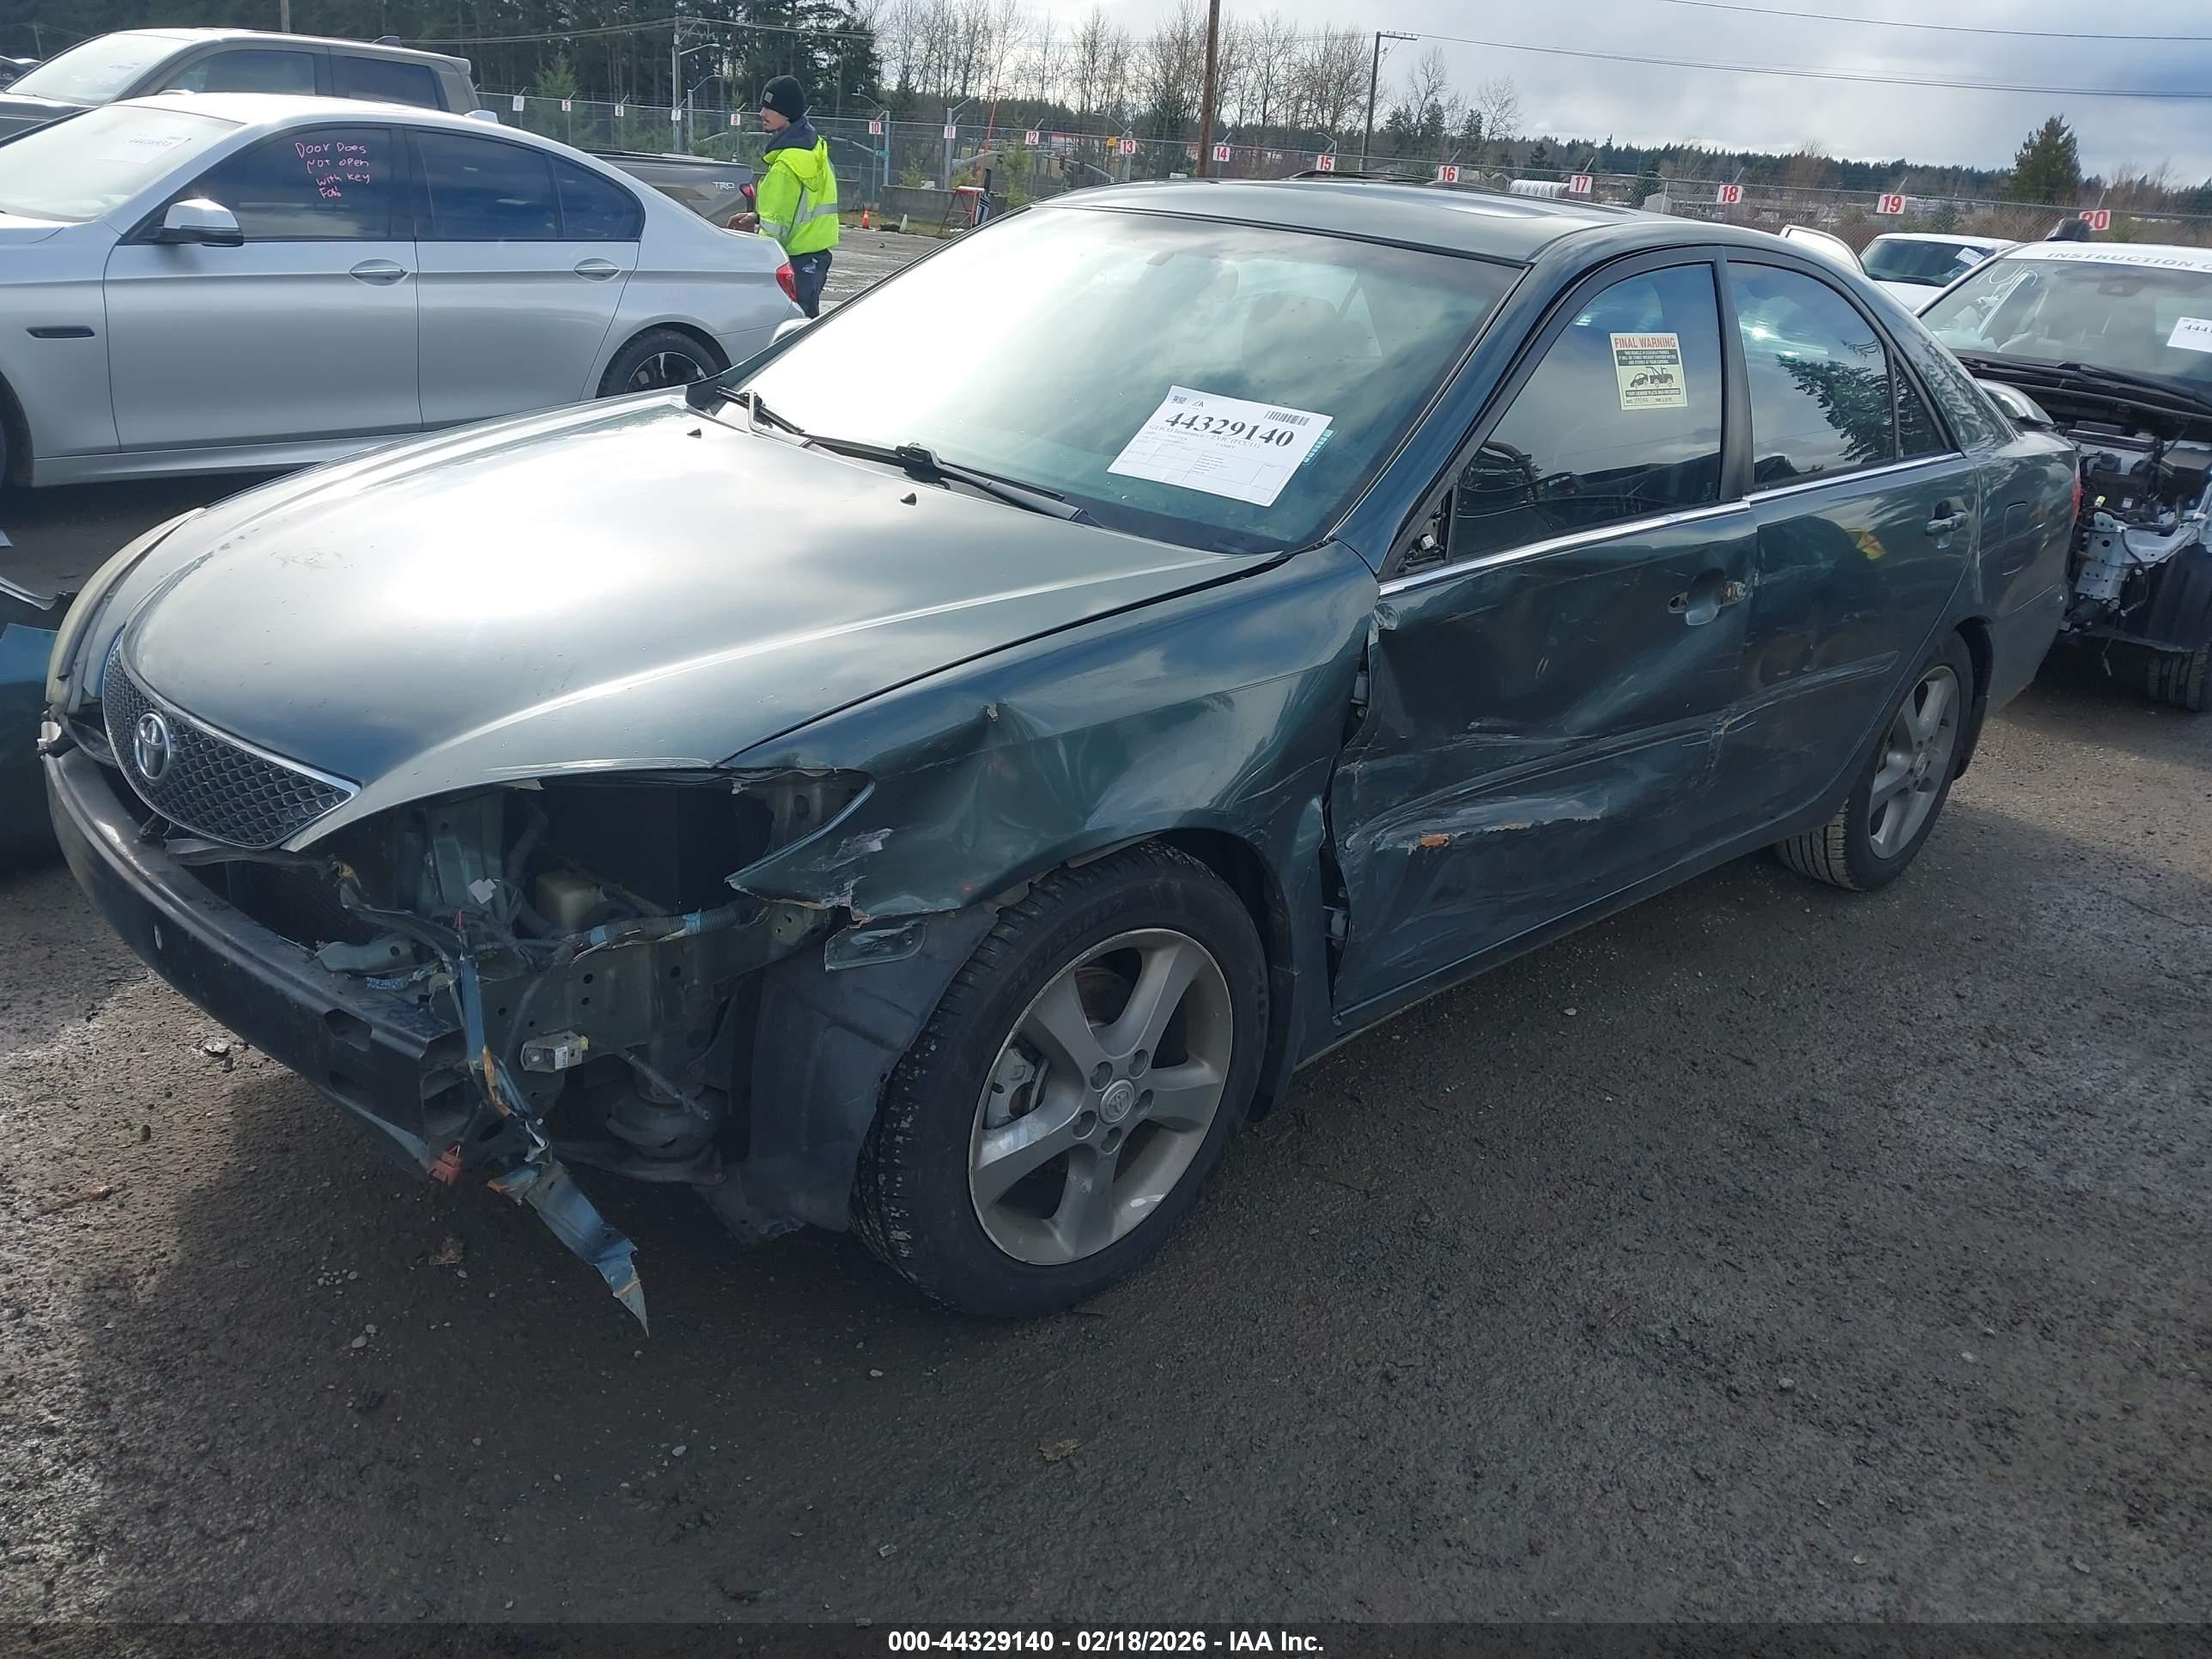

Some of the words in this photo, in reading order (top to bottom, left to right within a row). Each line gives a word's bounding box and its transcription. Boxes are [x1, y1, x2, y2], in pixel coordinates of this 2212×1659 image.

[872, 123, 879, 133] 10
[1028, 132, 1036, 143] 12
[295, 143, 330, 158] Door
[337, 142, 367, 154] Does
[1122, 141, 1133, 154] 13
[1217, 148, 1227, 161] 14
[1320, 156, 1333, 170] 15
[1443, 167, 1455, 181] 16
[1576, 176, 1589, 191] 17
[1722, 186, 1739, 202] 18
[1882, 196, 1902, 213] 19
[2047, 252, 2193, 267] INSTRUCTION
[1614, 337, 1638, 348] FINAL
[1639, 337, 1675, 348] WARNING
[1165, 412, 1295, 447] 44329140
